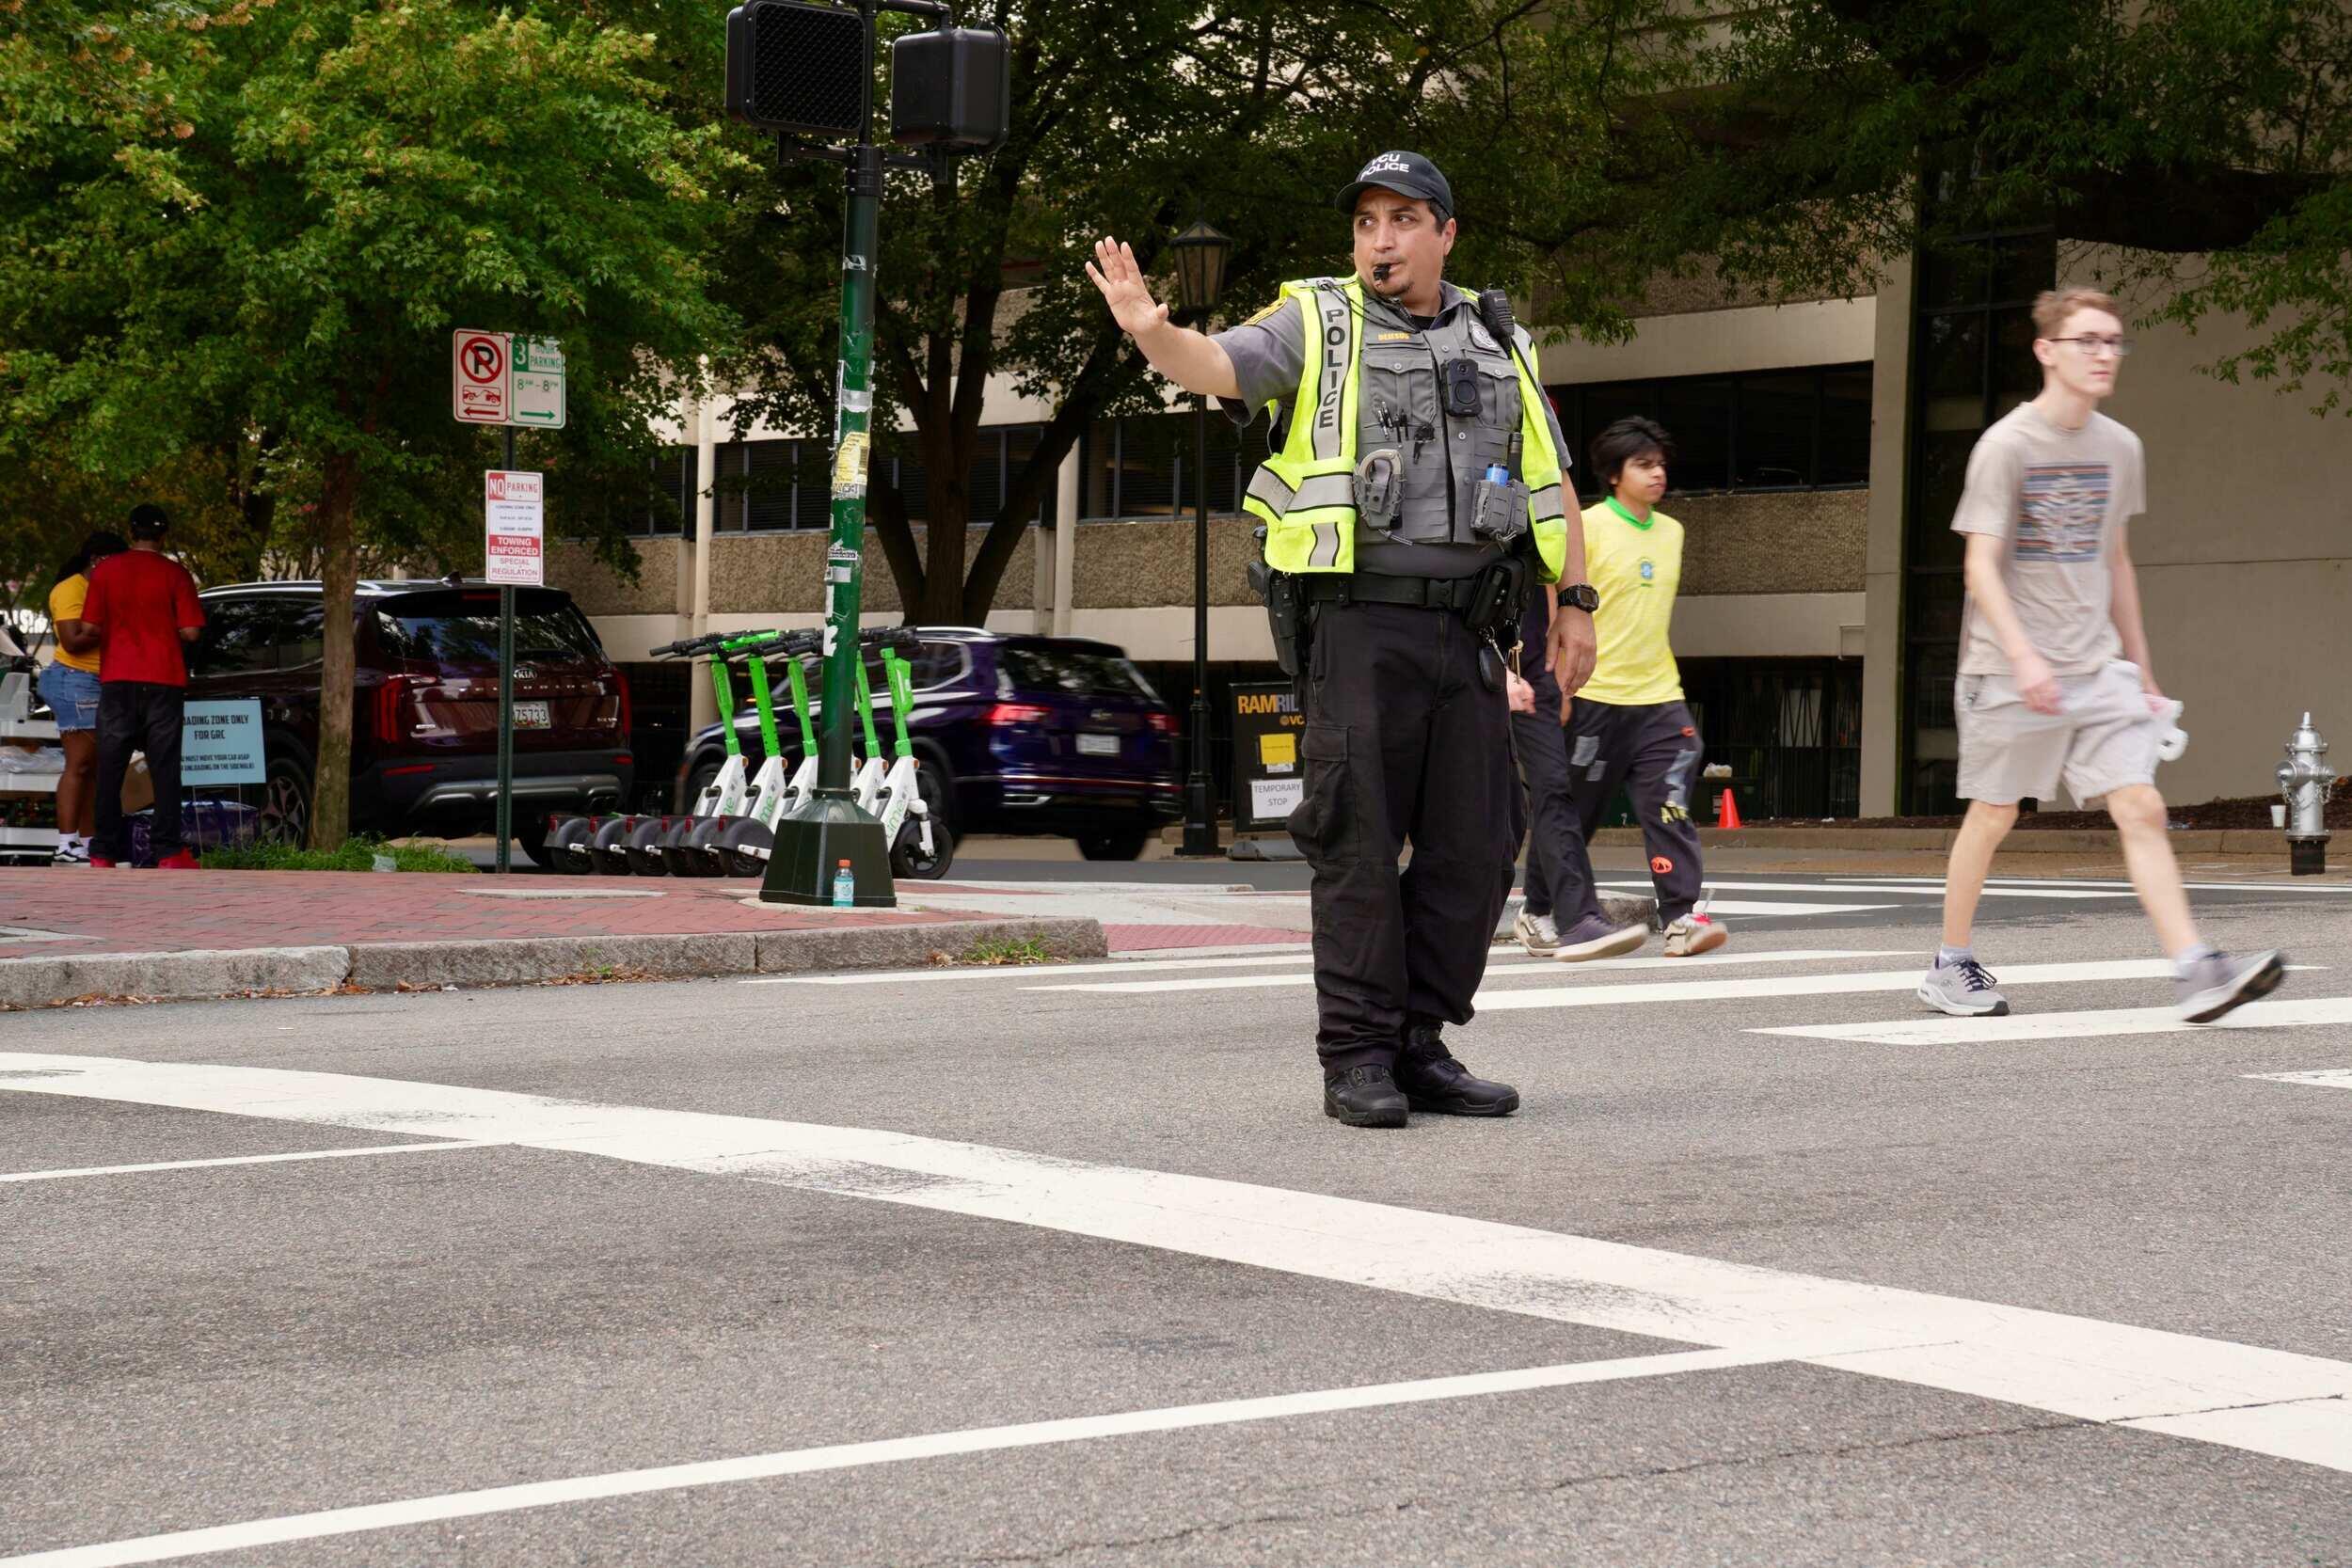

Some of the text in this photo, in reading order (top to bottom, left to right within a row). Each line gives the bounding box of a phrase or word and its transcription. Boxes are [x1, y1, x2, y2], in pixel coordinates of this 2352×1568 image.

[1372, 153, 1401, 166] VCU
[515, 342, 527, 365] 3
[531, 356, 561, 370] PARKING
[1318, 309, 1346, 429] POLICE
[489, 479, 538, 496] NO PARKING
[498, 536, 532, 546] TOWING
[490, 546, 538, 555] ENFORCED
[499, 557, 531, 565] SPECIAL
[492, 567, 538, 577] REGULATION
[517, 671, 534, 679] KIA
[183, 714, 249, 725] OADING ZONE ONLY
[1280, 715, 1305, 725] @VC
[195, 730, 226, 740] FOR GRC
[1254, 783, 1301, 793] TEMPORARY
[1268, 798, 1288, 807] STOP
